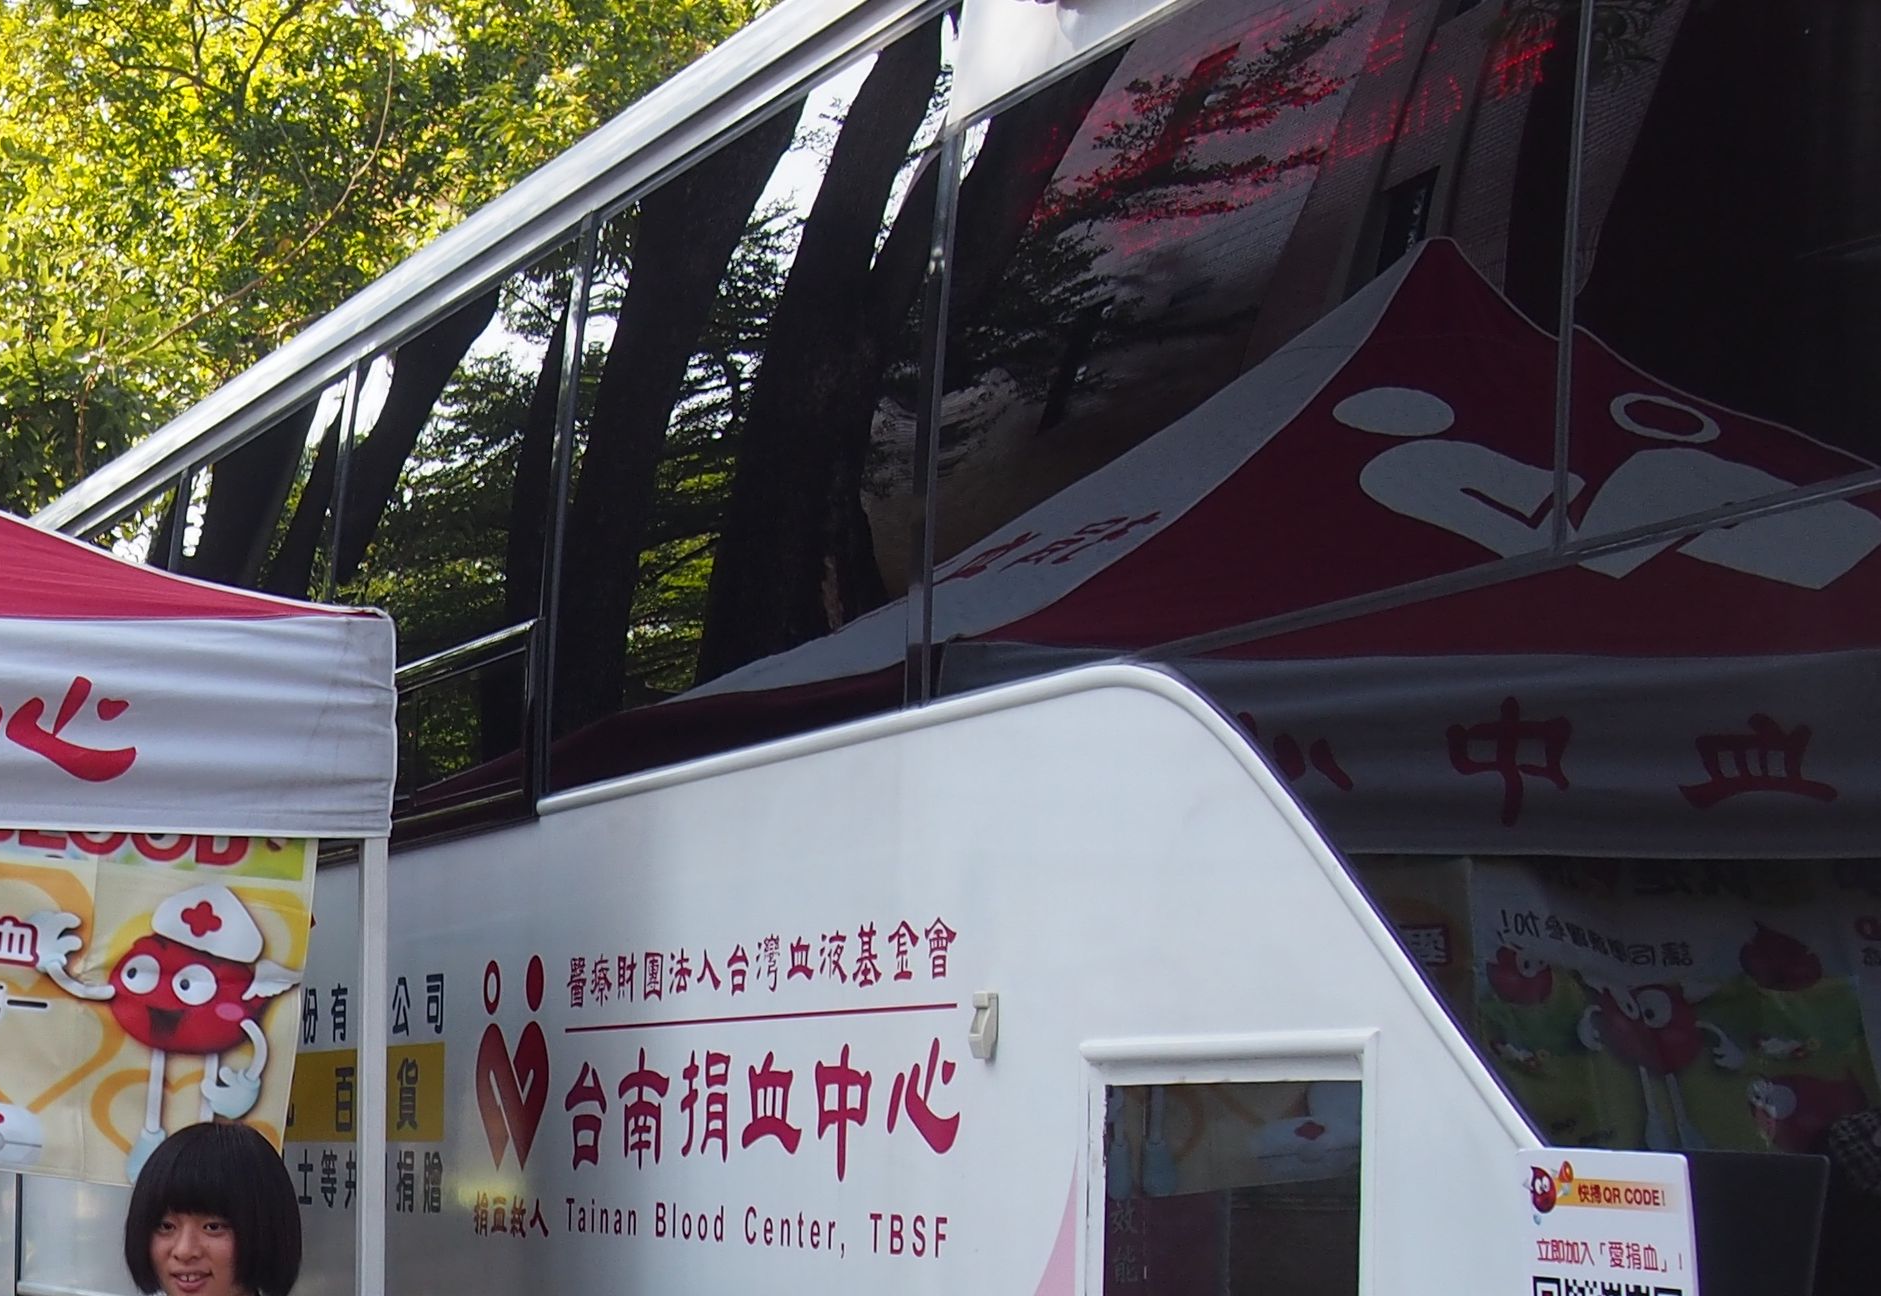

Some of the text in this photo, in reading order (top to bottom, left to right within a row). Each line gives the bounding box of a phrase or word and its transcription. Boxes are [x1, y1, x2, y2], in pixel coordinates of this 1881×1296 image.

[567, 917, 958, 1008] 醫療財團法人台灣血液基金會
[565, 1037, 961, 1182] 台南捐血中心
[473, 1190, 549, 1240] 捐血救人
[566, 1198, 949, 1259] Tainan Blood Center, TBSF
